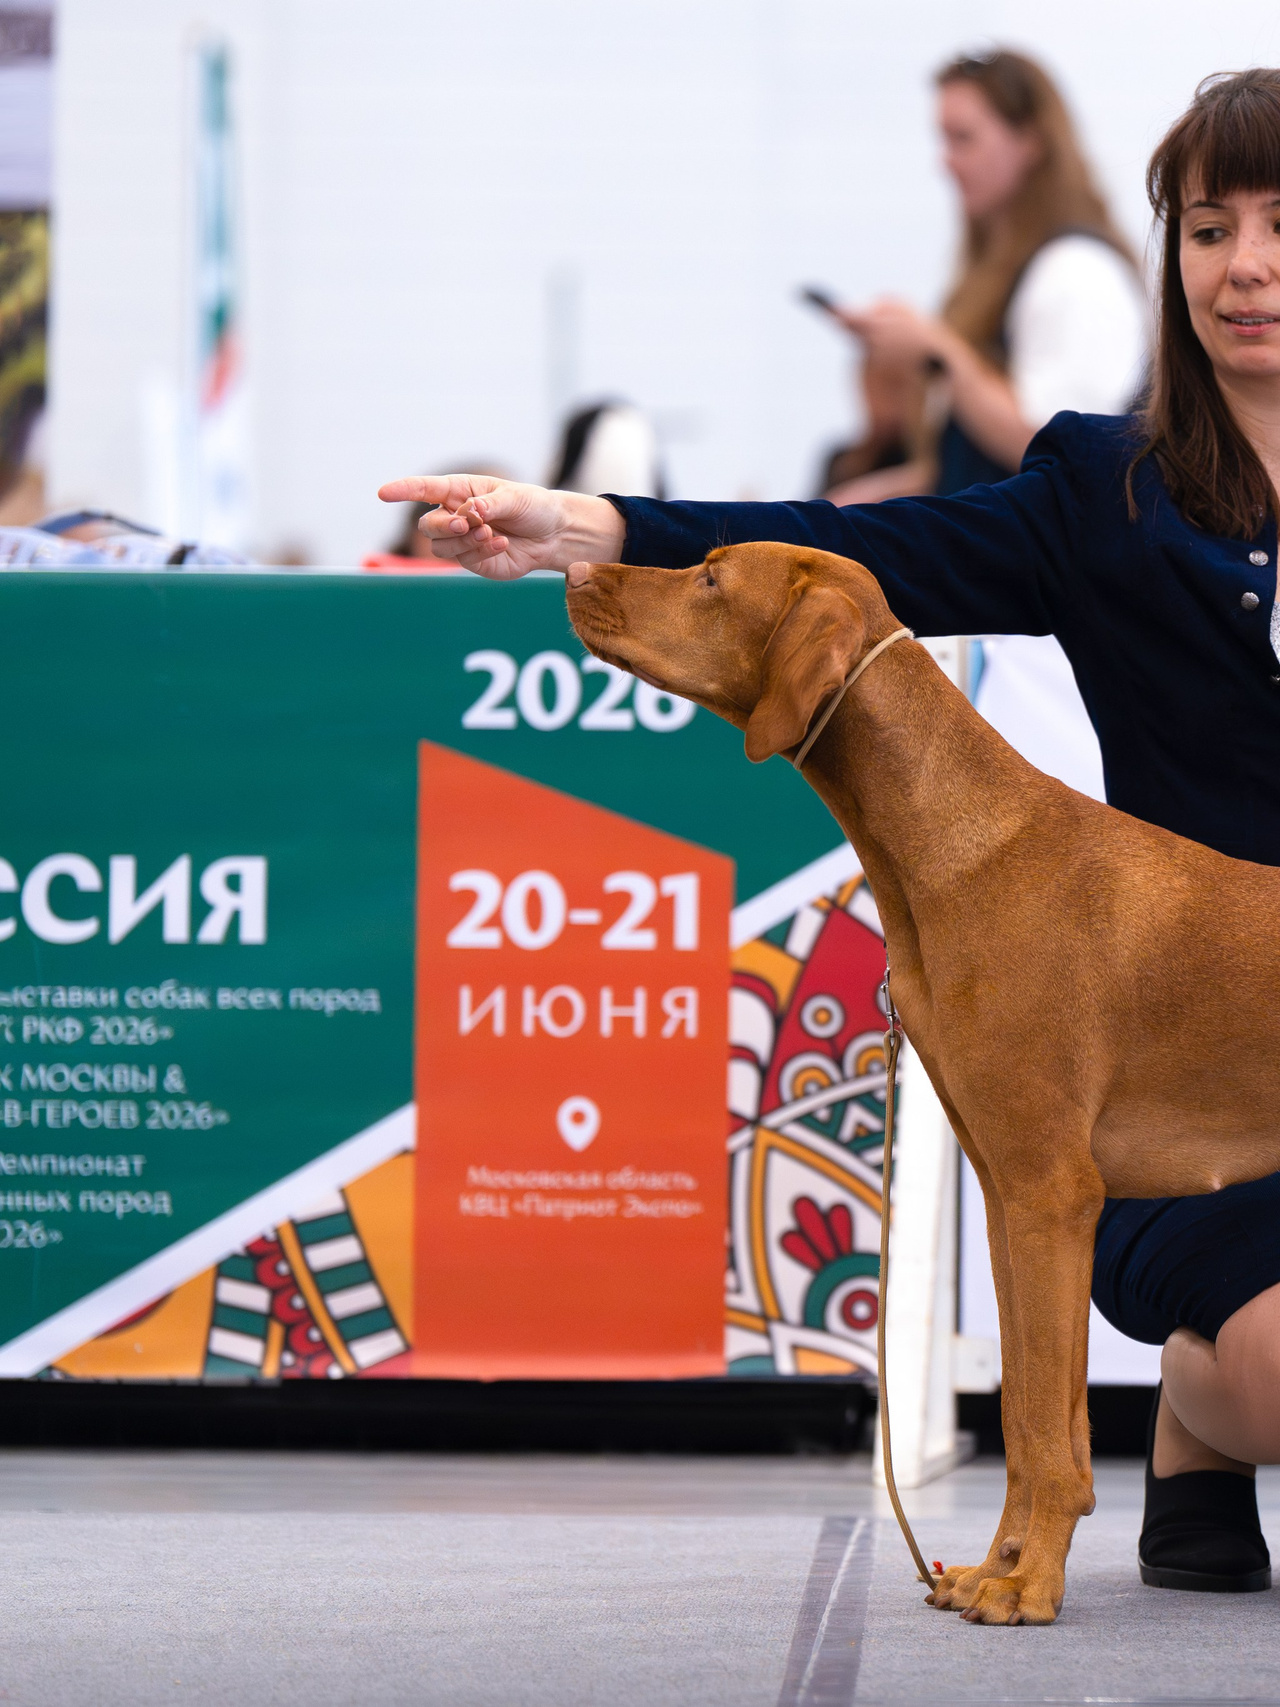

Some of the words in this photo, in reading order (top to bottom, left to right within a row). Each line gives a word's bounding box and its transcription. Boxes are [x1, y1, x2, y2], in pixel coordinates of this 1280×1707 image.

[461, 649, 698, 732] 2026
[0, 852, 268, 945] СИЯ
[446, 868, 699, 951] 20-21
[125, 978, 212, 1010] собак
[216, 986, 283, 1010] всех
[288, 987, 382, 1017] пород
[458, 984, 700, 1040] ИЮНЯ
[22, 1014, 84, 1044] РКФ
[20, 1062, 158, 1094] МОСКВЫ
[162, 1063, 188, 1094] &
[78, 1189, 174, 1220] пород
